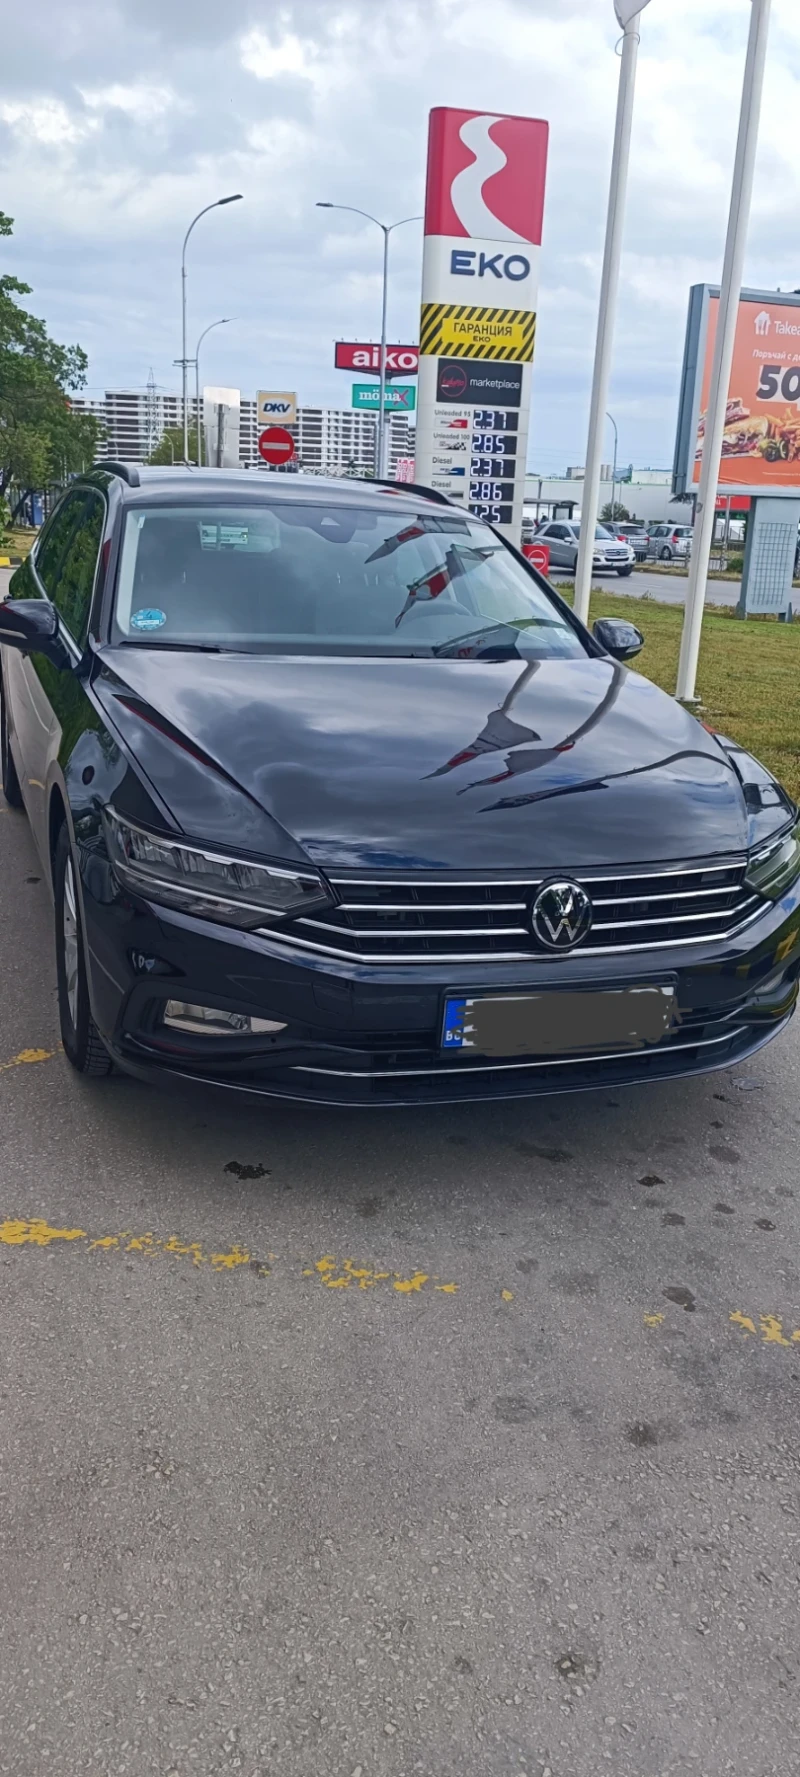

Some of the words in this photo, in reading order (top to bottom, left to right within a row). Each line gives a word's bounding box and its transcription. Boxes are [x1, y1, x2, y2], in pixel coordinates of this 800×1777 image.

[450, 249, 531, 281] EKO
[453, 322, 513, 337] ГАРАНЦИЯ
[472, 335, 491, 343] EKO
[752, 349, 786, 360] Поръчай
[469, 378, 520, 390] marketplace
[263, 402, 291, 413] DKV
[434, 409, 462, 417] Unleaded
[473, 410, 507, 429] 2.37
[433, 432, 460, 440] Unleaded
[472, 434, 505, 453] 2.85
[470, 458, 504, 476] 2.37
[431, 480, 452, 488] Diesel
[469, 481, 503, 501] 2.86
